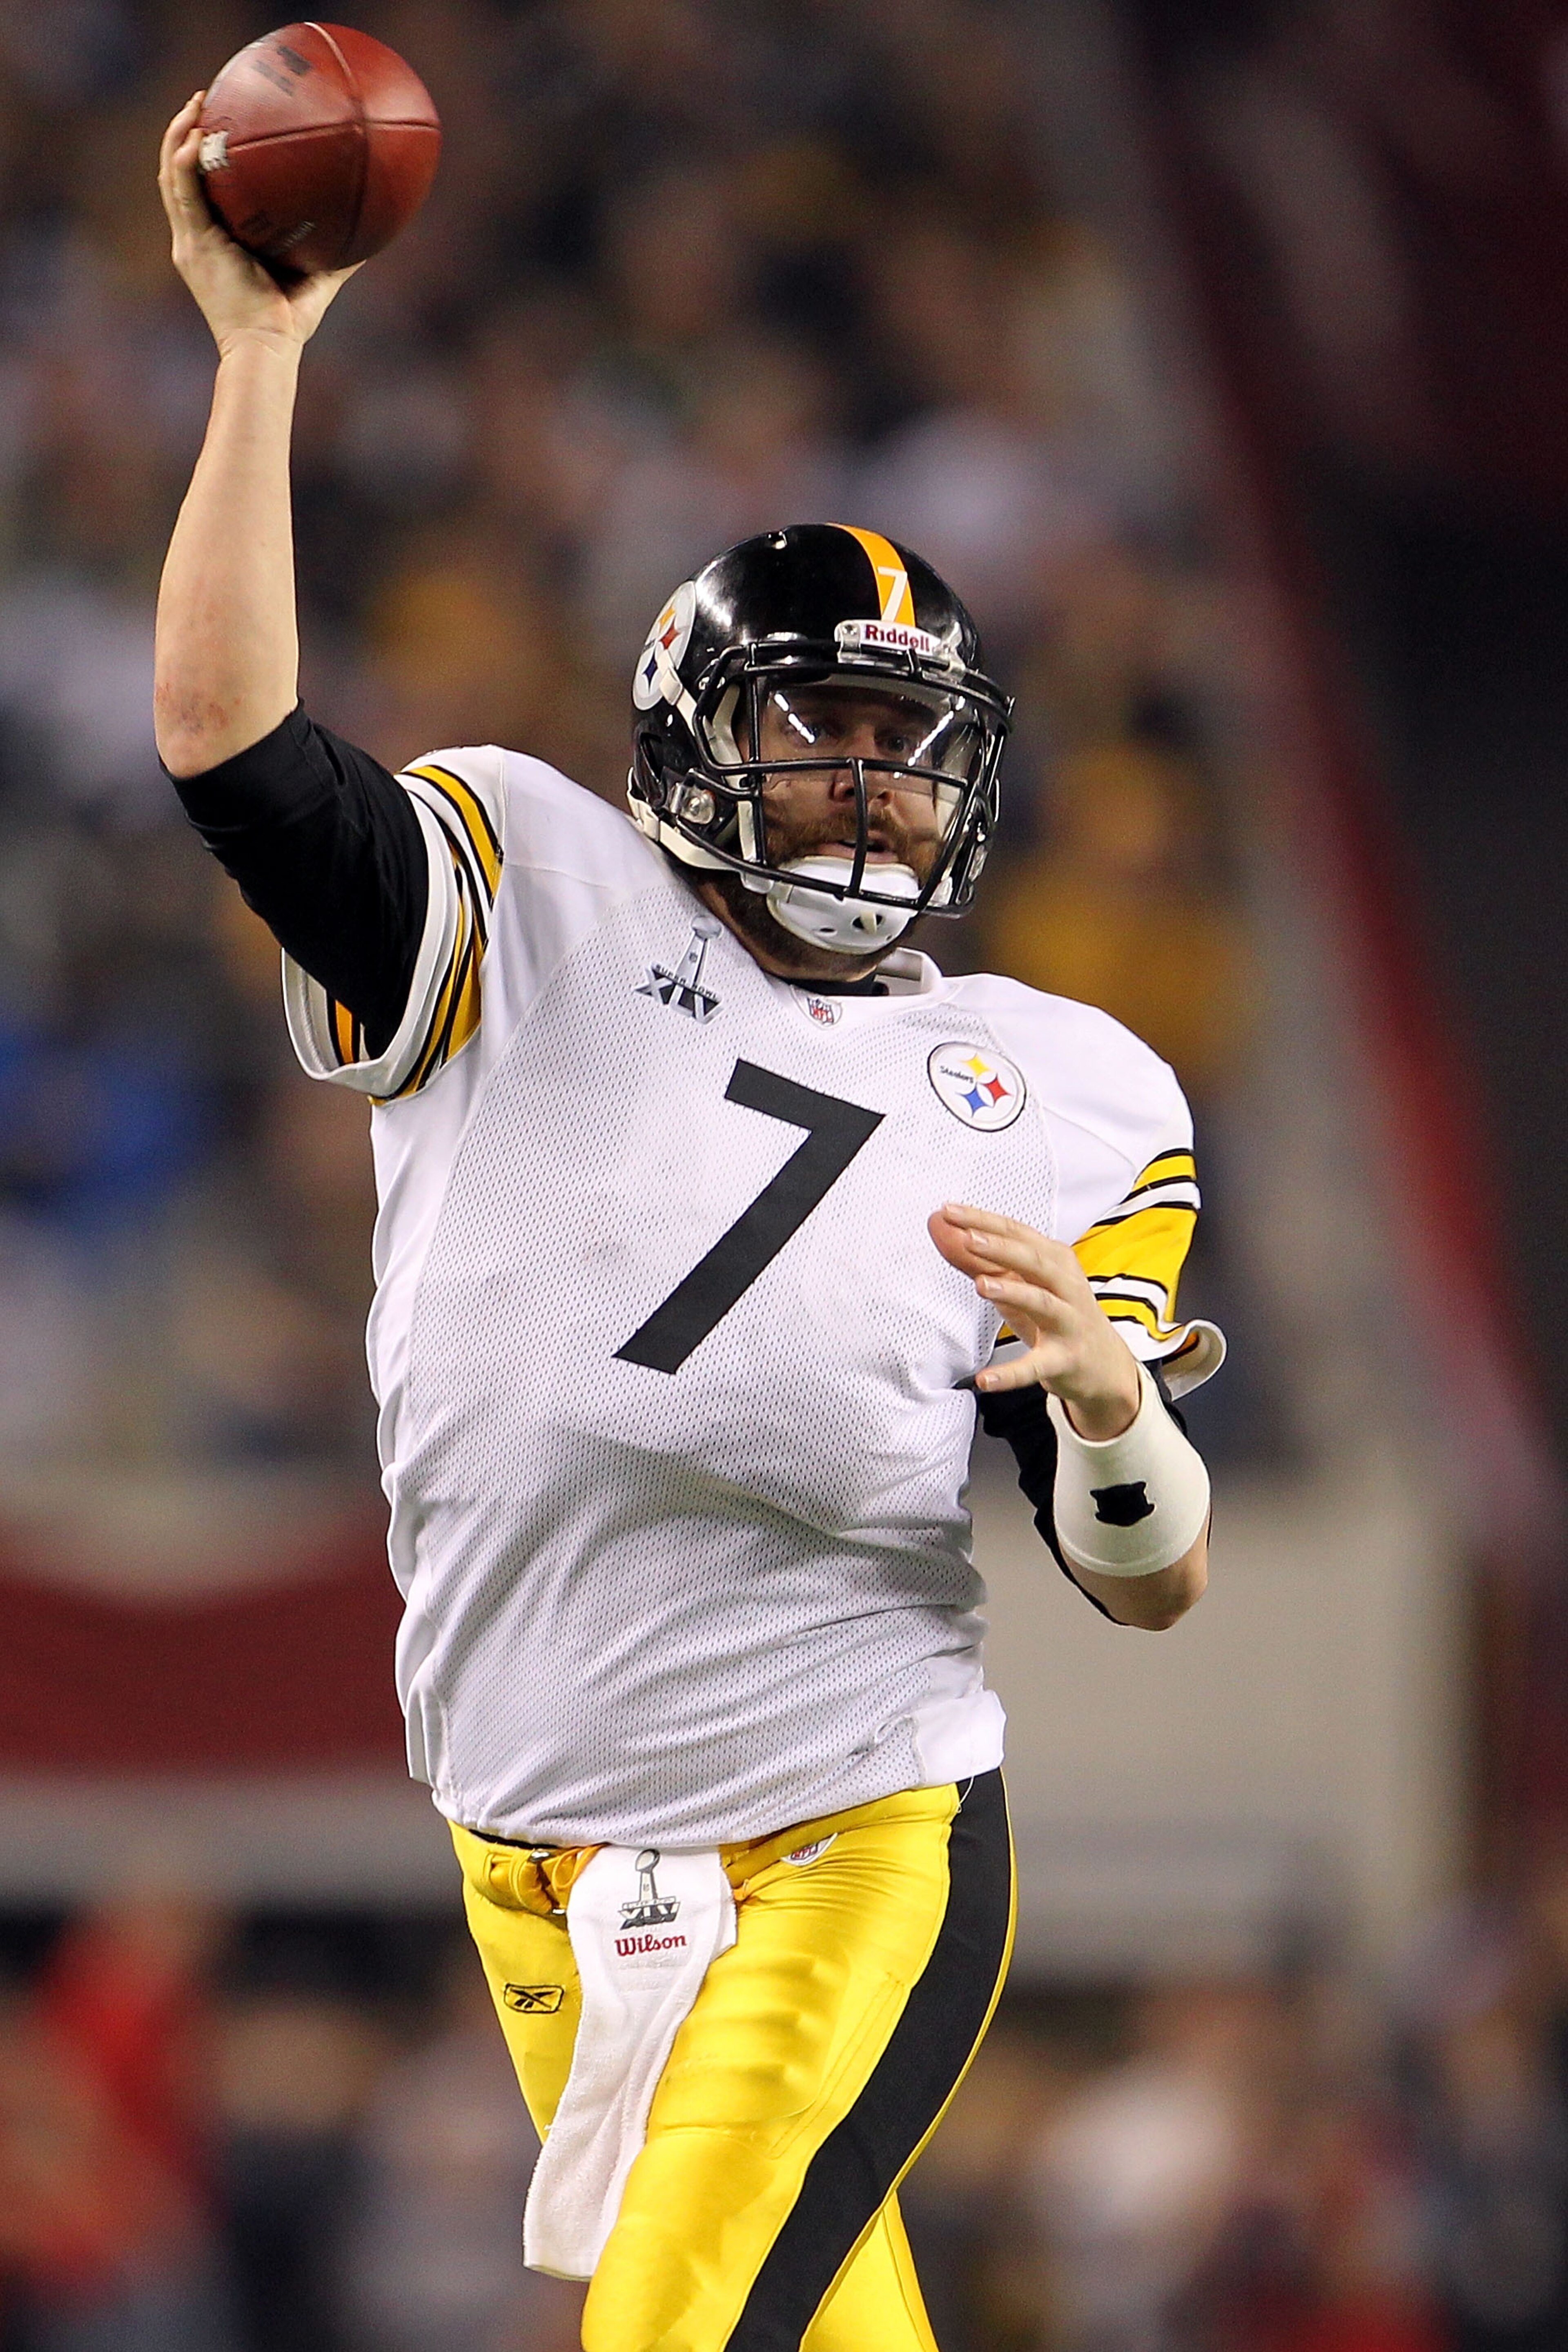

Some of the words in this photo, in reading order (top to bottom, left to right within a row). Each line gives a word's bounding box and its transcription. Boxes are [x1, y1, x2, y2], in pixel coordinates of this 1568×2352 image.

[877, 566, 908, 622] 7
[865, 624, 930, 652] Riddell
[940, 1065, 974, 1084] Steelers
[612, 1057, 886, 1375] 7
[793, 1846, 817, 1860] NFL
[615, 1934, 687, 1957] Wilson
